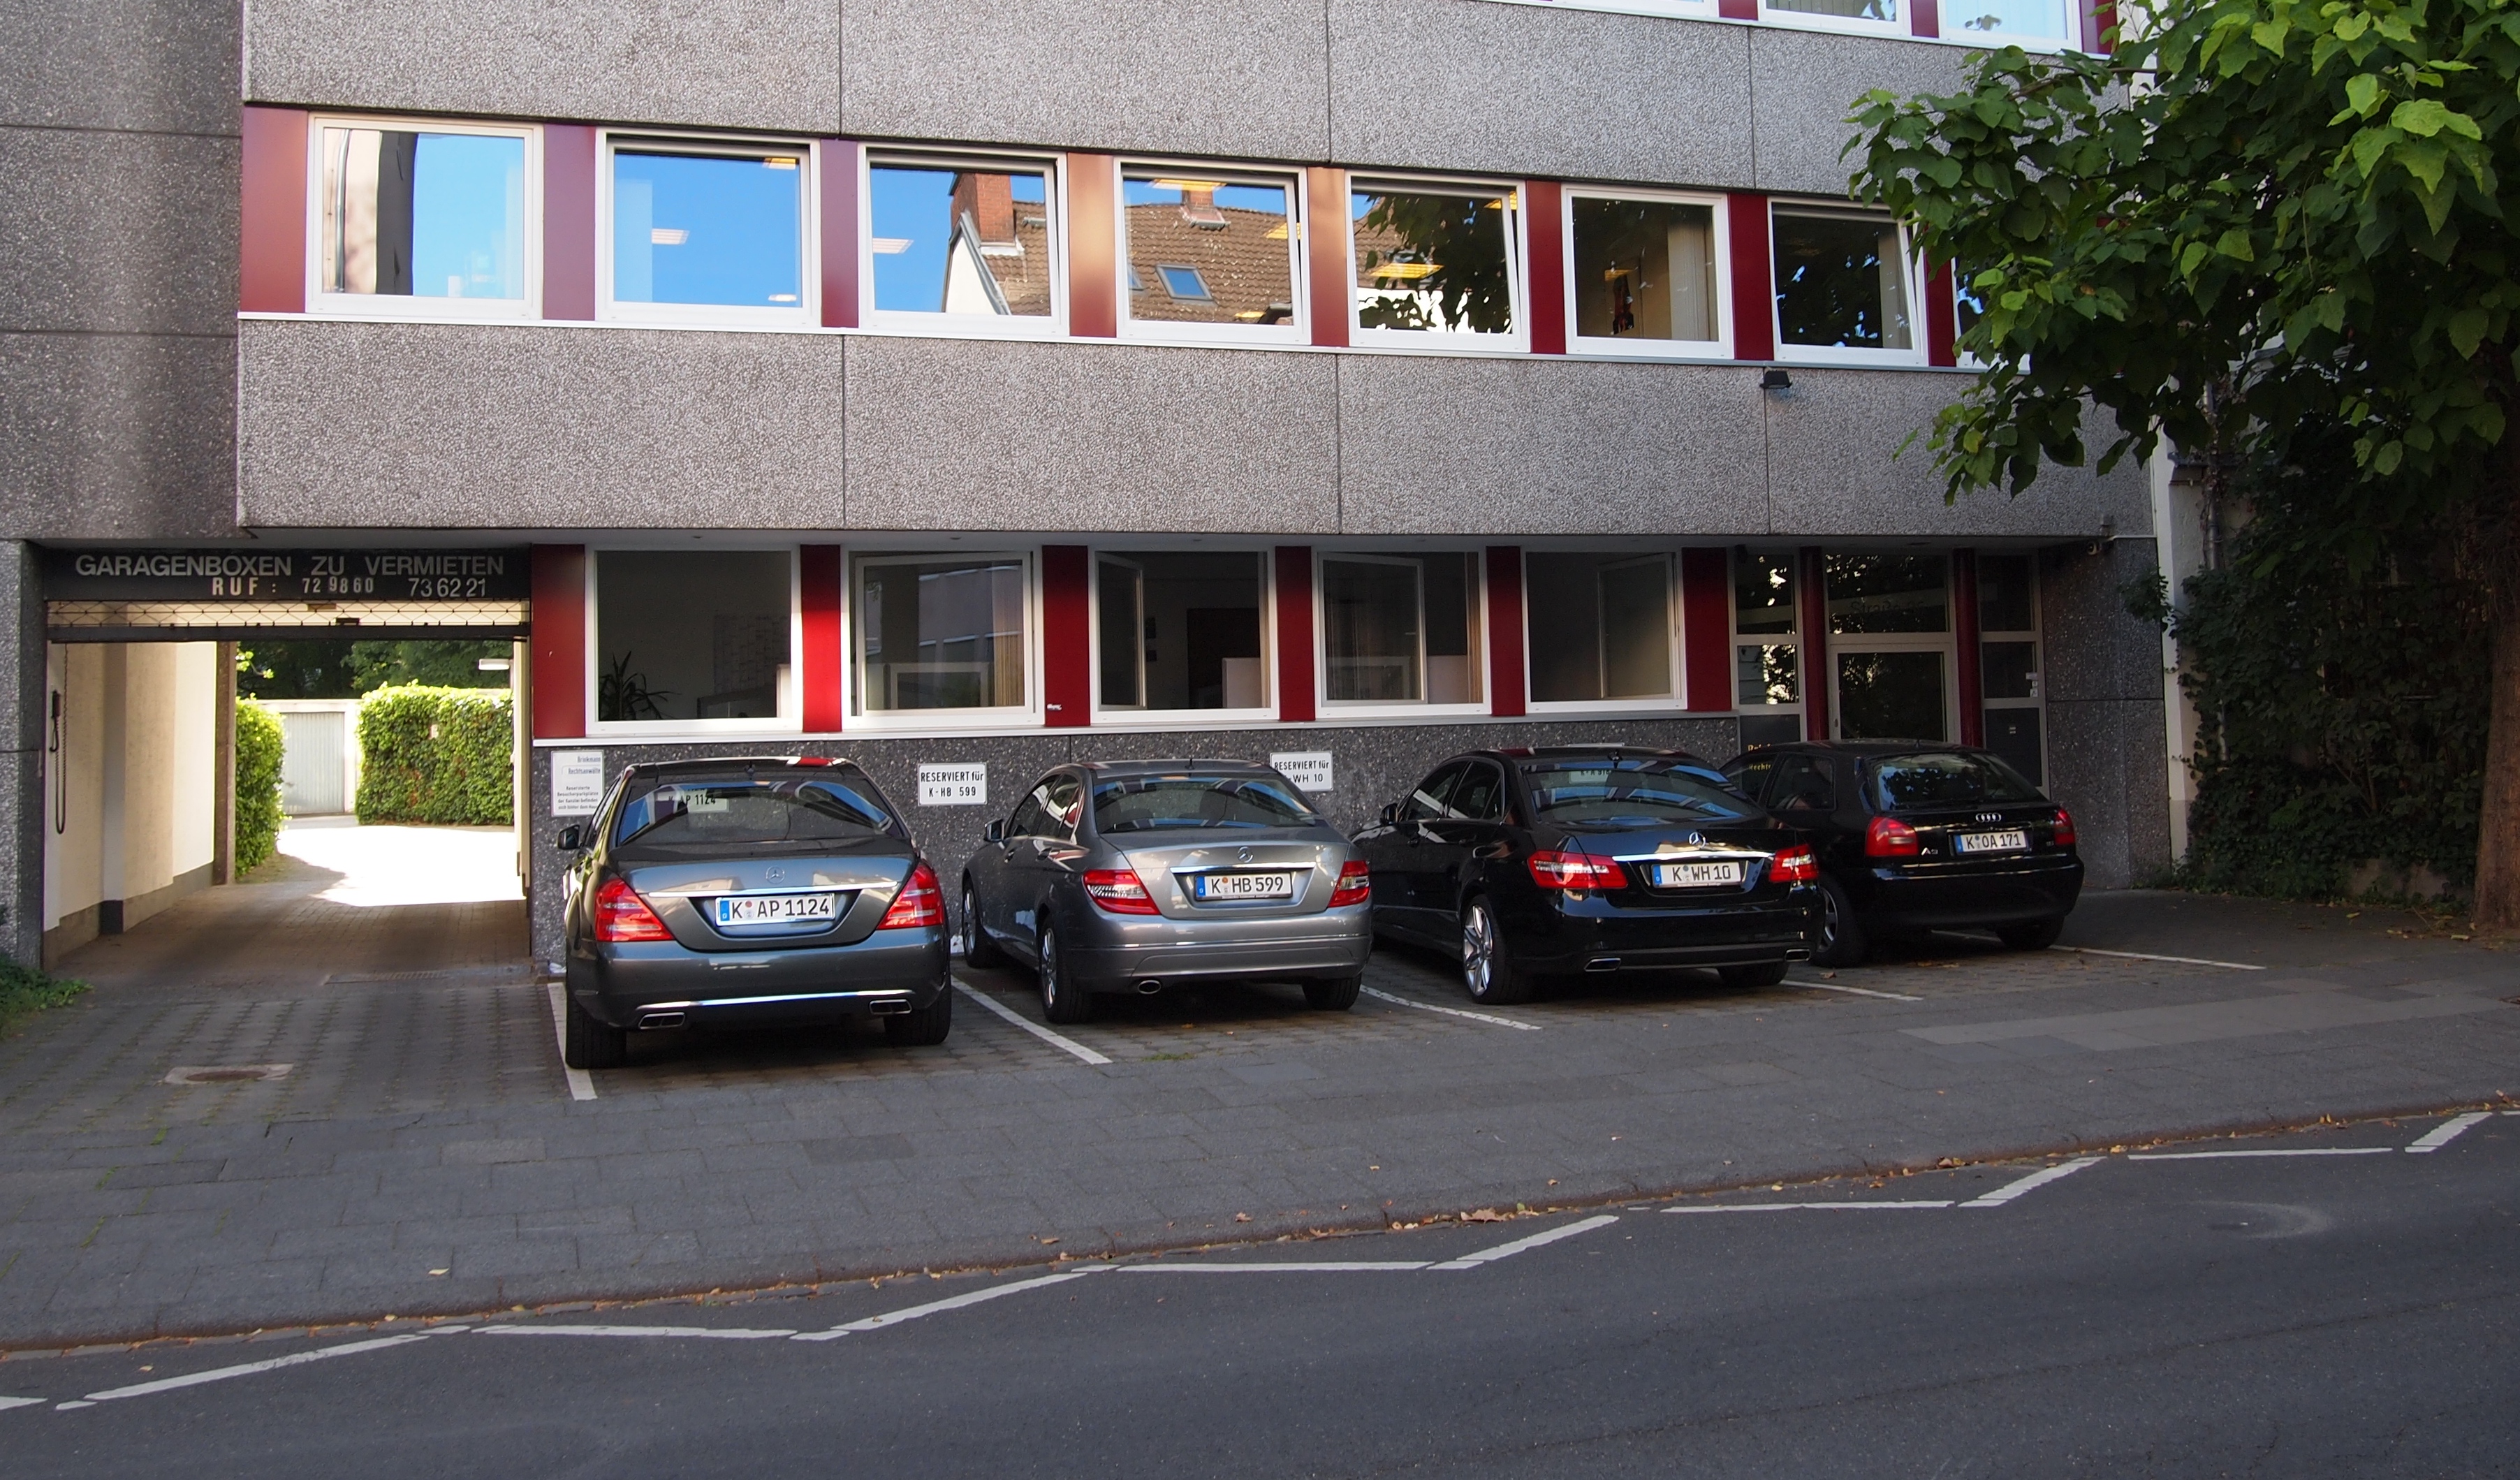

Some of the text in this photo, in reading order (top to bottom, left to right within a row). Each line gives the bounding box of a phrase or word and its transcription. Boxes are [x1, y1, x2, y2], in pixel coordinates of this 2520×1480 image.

[75, 555, 504, 576] GARAGENBOXEN ZU VERMIETEN
[1274, 759, 1329, 771] RESERVIERT für
[921, 770, 984, 782] RESERVIERT für
[1314, 773, 1324, 782] 10
[959, 786, 976, 796] 599
[1966, 833, 2022, 849] K OA 171
[1672, 866, 1682, 881] K
[1691, 865, 1711, 881] WH
[1713, 865, 1731, 880] 10
[1211, 878, 1221, 894] K
[1231, 877, 1252, 893] HB
[1255, 877, 1284, 892] 599
[732, 901, 743, 919] K
[757, 900, 780, 918] AP
[785, 897, 830, 916] 1124
